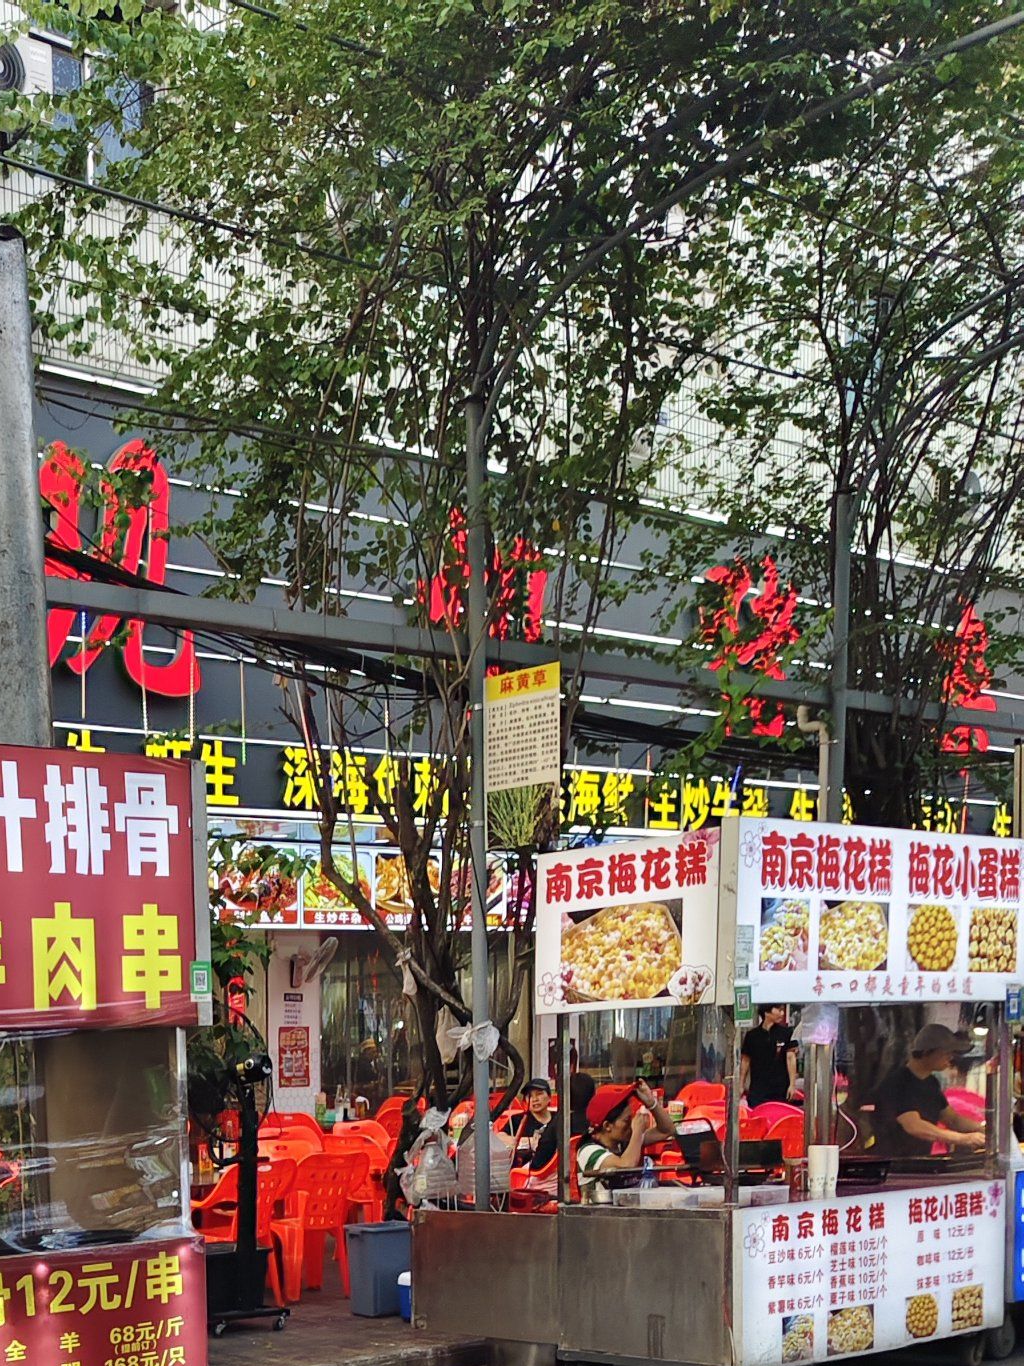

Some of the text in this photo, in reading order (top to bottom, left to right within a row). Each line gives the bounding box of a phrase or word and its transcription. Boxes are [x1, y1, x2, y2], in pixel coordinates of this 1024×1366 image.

[500, 669, 548, 694] 麻黄草
[546, 840, 708, 904] 南京梅花糕
[760, 831, 1021, 903] 南京梅花糕 梅花小蛋糕
[813, 974, 973, 997] 每一口都是童年的味道
[772, 1191, 984, 1243] 南京梅花糕 梅花小蛋糕
[948, 1224, 974, 1238] 12元/份
[768, 1244, 825, 1264] 豆沙味 6元/个
[830, 1236, 888, 1256] 榴莲味 10元/个
[948, 1247, 974, 1261] 12元/份
[830, 1252, 888, 1272] 芝士味 10元/个
[798, 1269, 824, 1285] 6元/个
[830, 1269, 888, 1289] 香蕉味 10元/个
[947, 1270, 974, 1284] 12元/份
[798, 1294, 824, 1310] 6元/个
[859, 1285, 888, 1301] 10元/个
[110, 1316, 184, 1344] 68元/斤
